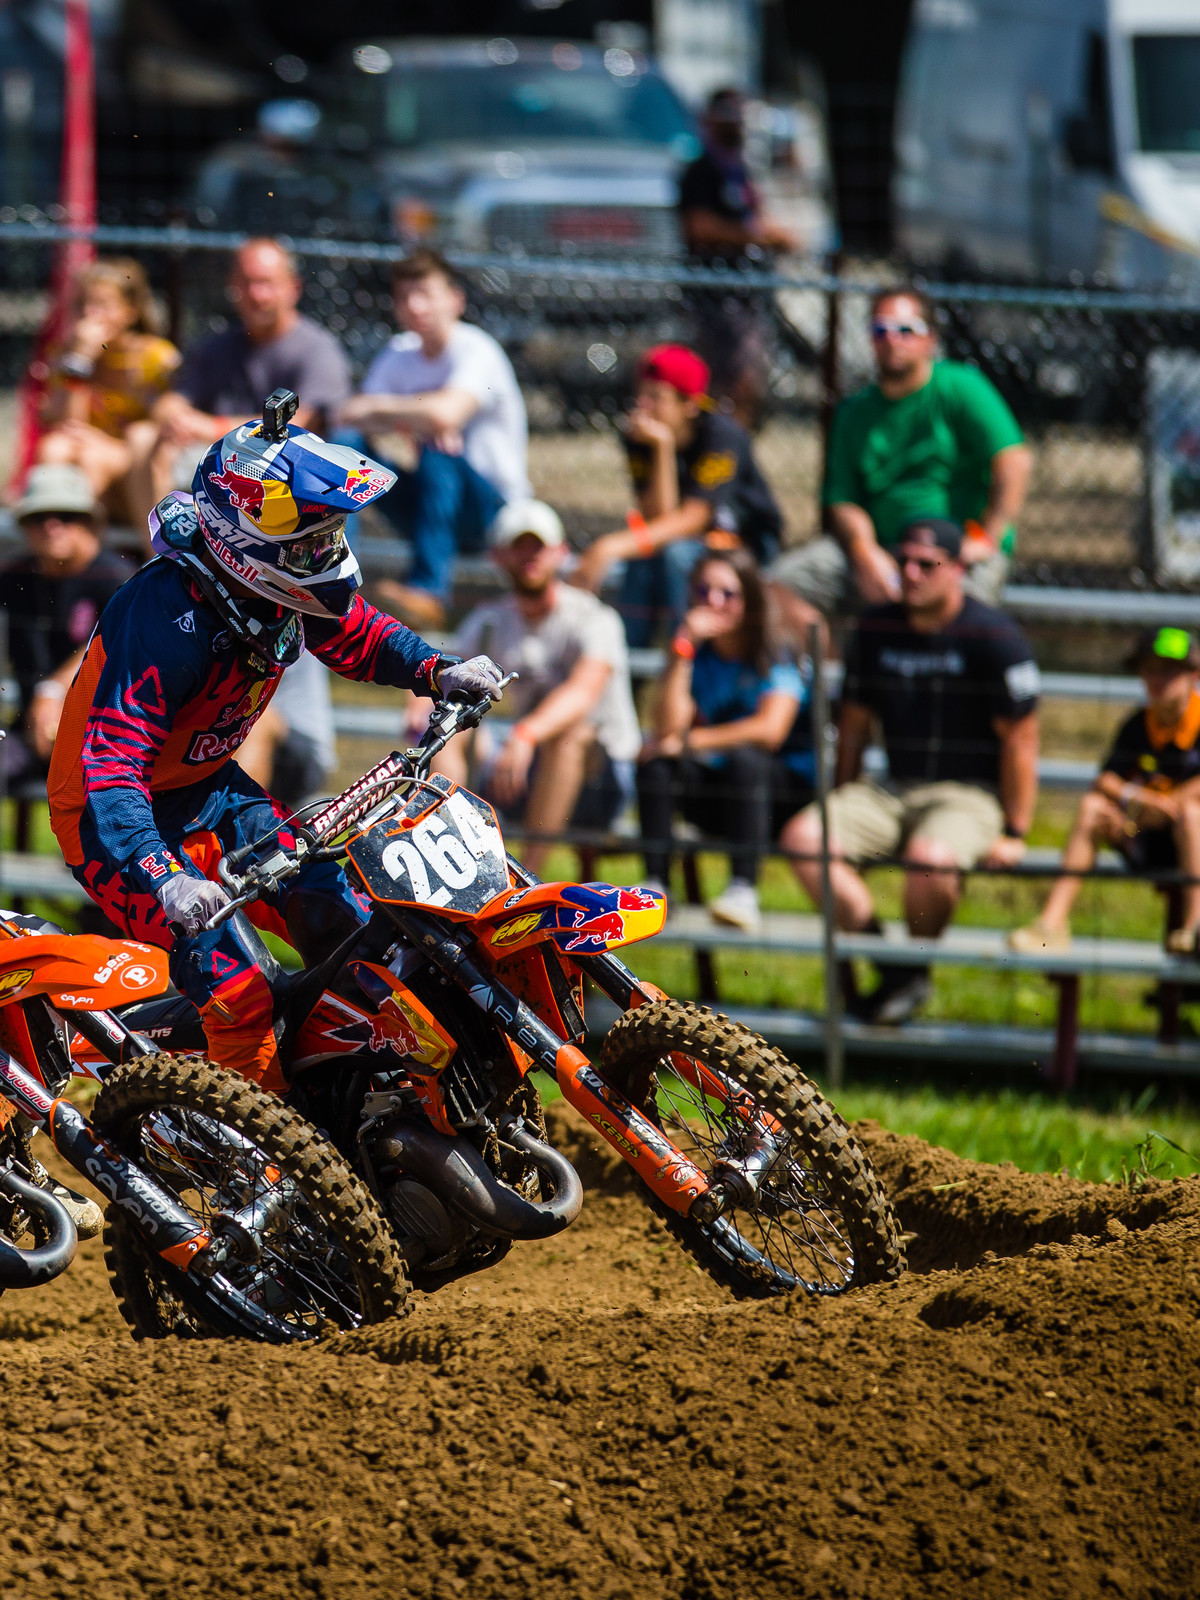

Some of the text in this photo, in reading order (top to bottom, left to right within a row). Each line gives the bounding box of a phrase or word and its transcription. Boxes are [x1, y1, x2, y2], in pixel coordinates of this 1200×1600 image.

[196, 490, 266, 549] LEATT
[301, 504, 328, 513] LEATT
[220, 546, 260, 583] Bull
[137, 853, 168, 879] Bull
[382, 791, 507, 908] 264
[492, 911, 544, 943] FMF
